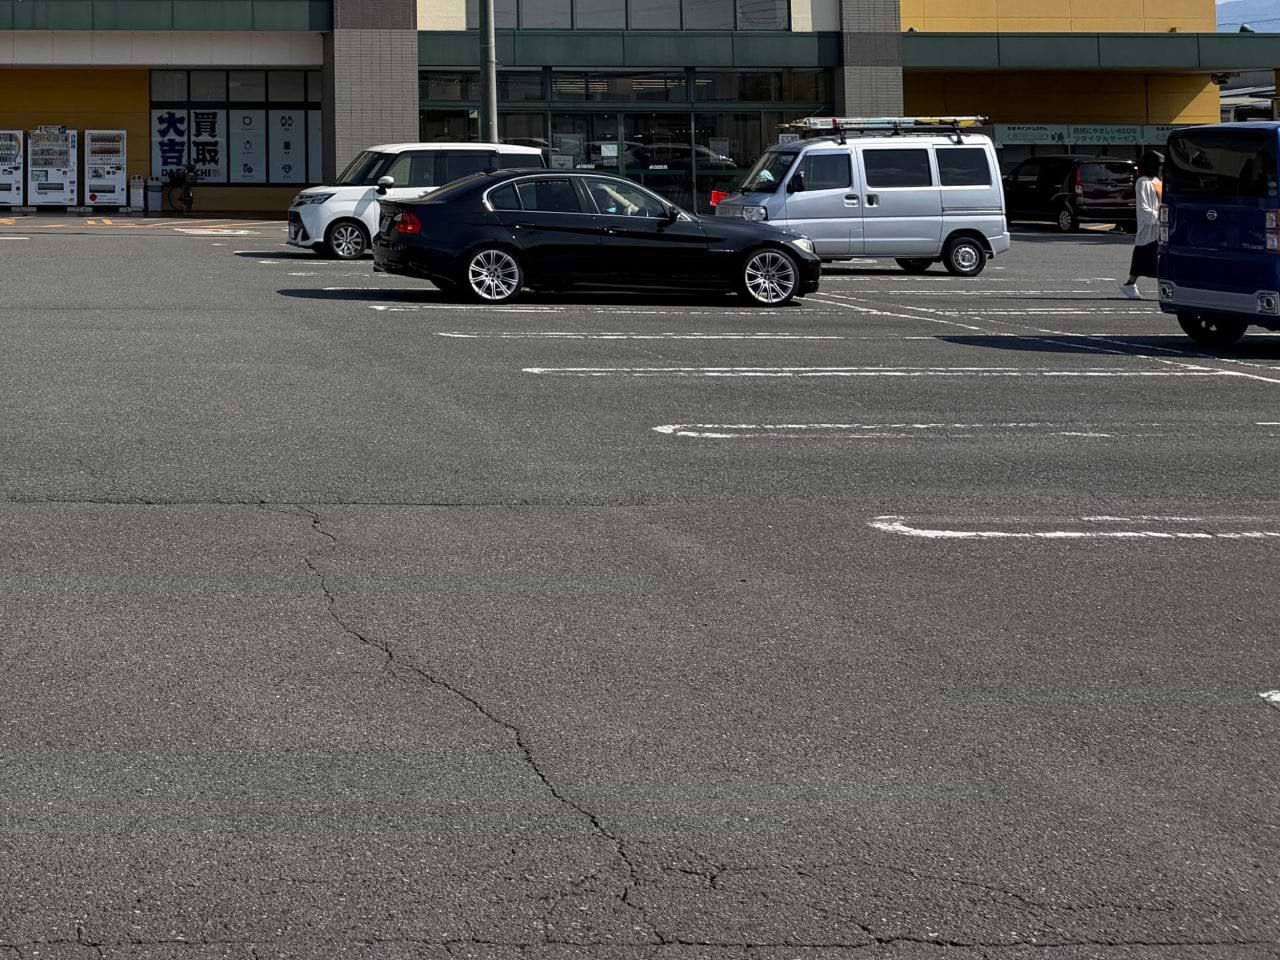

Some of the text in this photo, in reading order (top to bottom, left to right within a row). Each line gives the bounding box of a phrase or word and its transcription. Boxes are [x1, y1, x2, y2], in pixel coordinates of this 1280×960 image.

[157, 111, 187, 167] 大吉
[192, 111, 220, 166] 買取
[161, 168, 211, 178] DACHI
